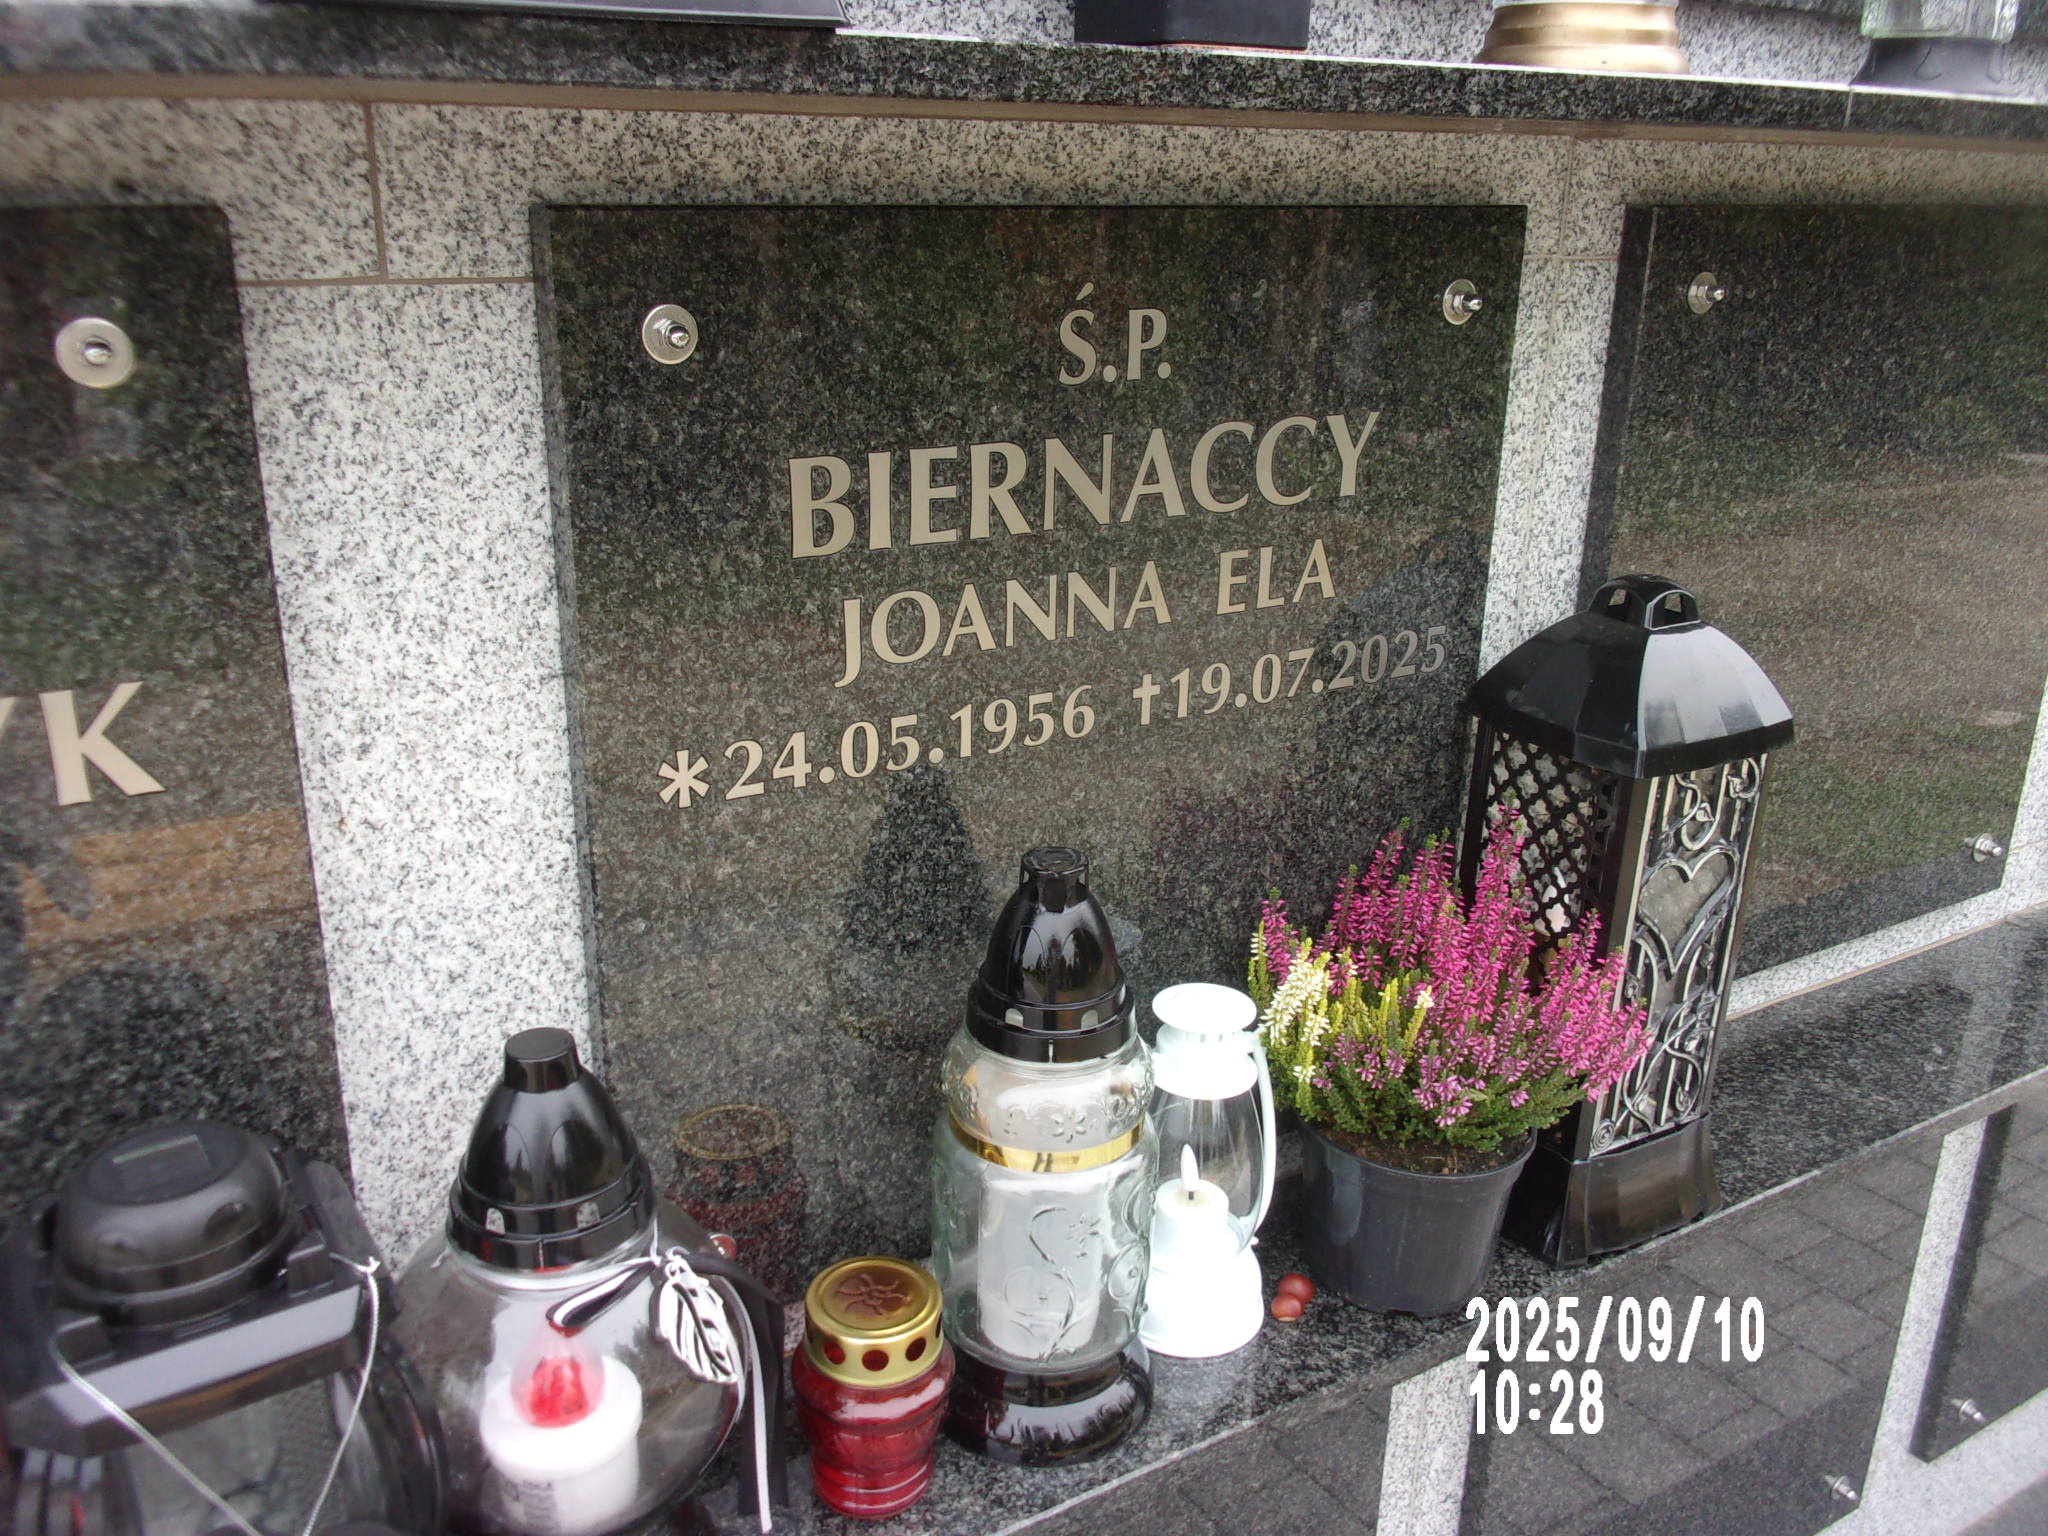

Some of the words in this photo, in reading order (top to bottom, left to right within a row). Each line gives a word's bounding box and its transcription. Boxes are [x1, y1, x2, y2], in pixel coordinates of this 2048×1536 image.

[1058, 282, 1173, 387] Ś.P.
[787, 411, 1380, 559] BIERNACCY
[833, 560, 1172, 688] JOANNA
[1216, 538, 1337, 616] ELA
[0, 680, 166, 806] K
